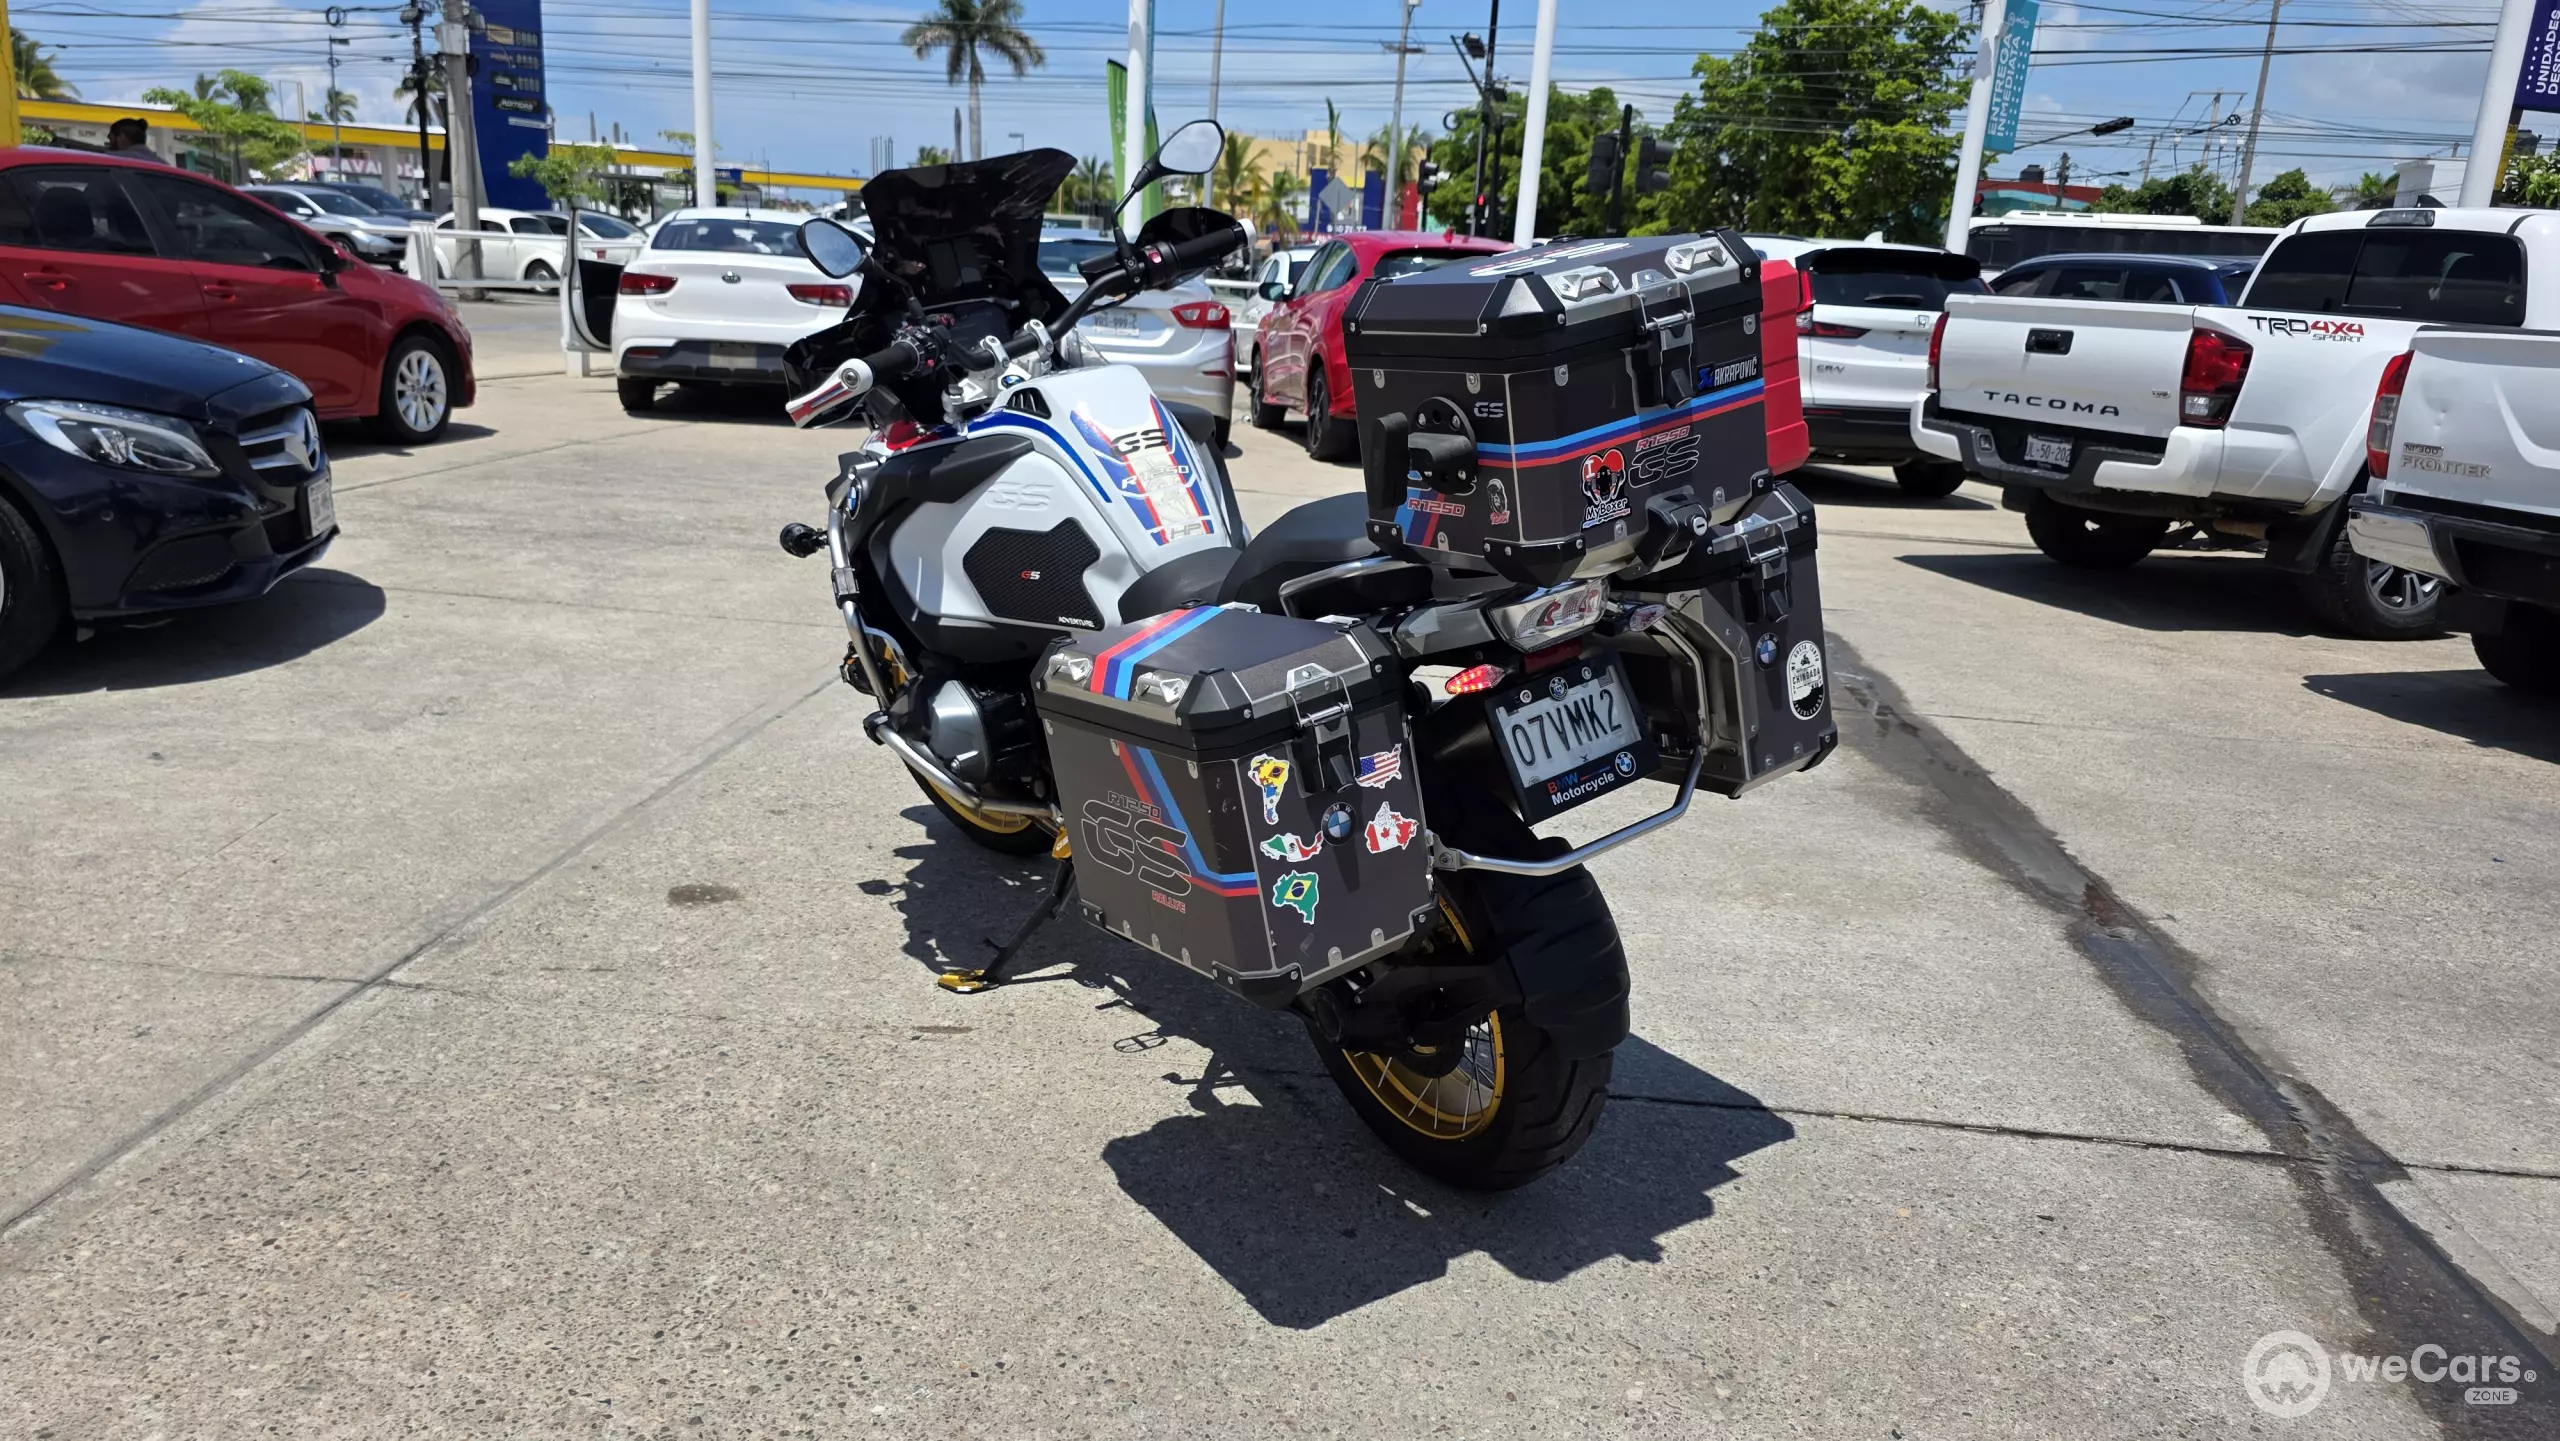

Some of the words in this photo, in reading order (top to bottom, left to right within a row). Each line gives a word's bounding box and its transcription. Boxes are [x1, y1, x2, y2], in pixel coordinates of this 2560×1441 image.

[2535, 9, 2560, 93] UNIDADES
[1988, 33, 2012, 136] ENTREGA
[1997, 35, 2020, 137] INMEDIATA
[2247, 316, 2310, 337] TRD
[2311, 320, 2364, 336] 4X4
[2312, 333, 2363, 342] SPORT
[1474, 402, 1504, 418] GS
[1984, 391, 2120, 416] TACOMA
[1111, 428, 1168, 456] GS
[1636, 425, 1690, 452] R1250
[1628, 434, 1702, 488] GS
[2400, 455, 2492, 479] FRONTIER
[1121, 465, 1190, 489] R1250
[984, 481, 1054, 512] GS
[1408, 498, 1465, 517] R1250
[1021, 570, 1041, 580] GS
[1058, 616, 1095, 628] ADVENTURE
[1512, 688, 1622, 767] 07VMK2
[1546, 772, 1579, 794] BMW
[1551, 772, 1615, 806] Motorcycle
[1107, 790, 1162, 820] R1250
[1323, 803, 1352, 822] BMW
[1081, 800, 1192, 896] GS
[1151, 890, 1186, 914] RALLYE
